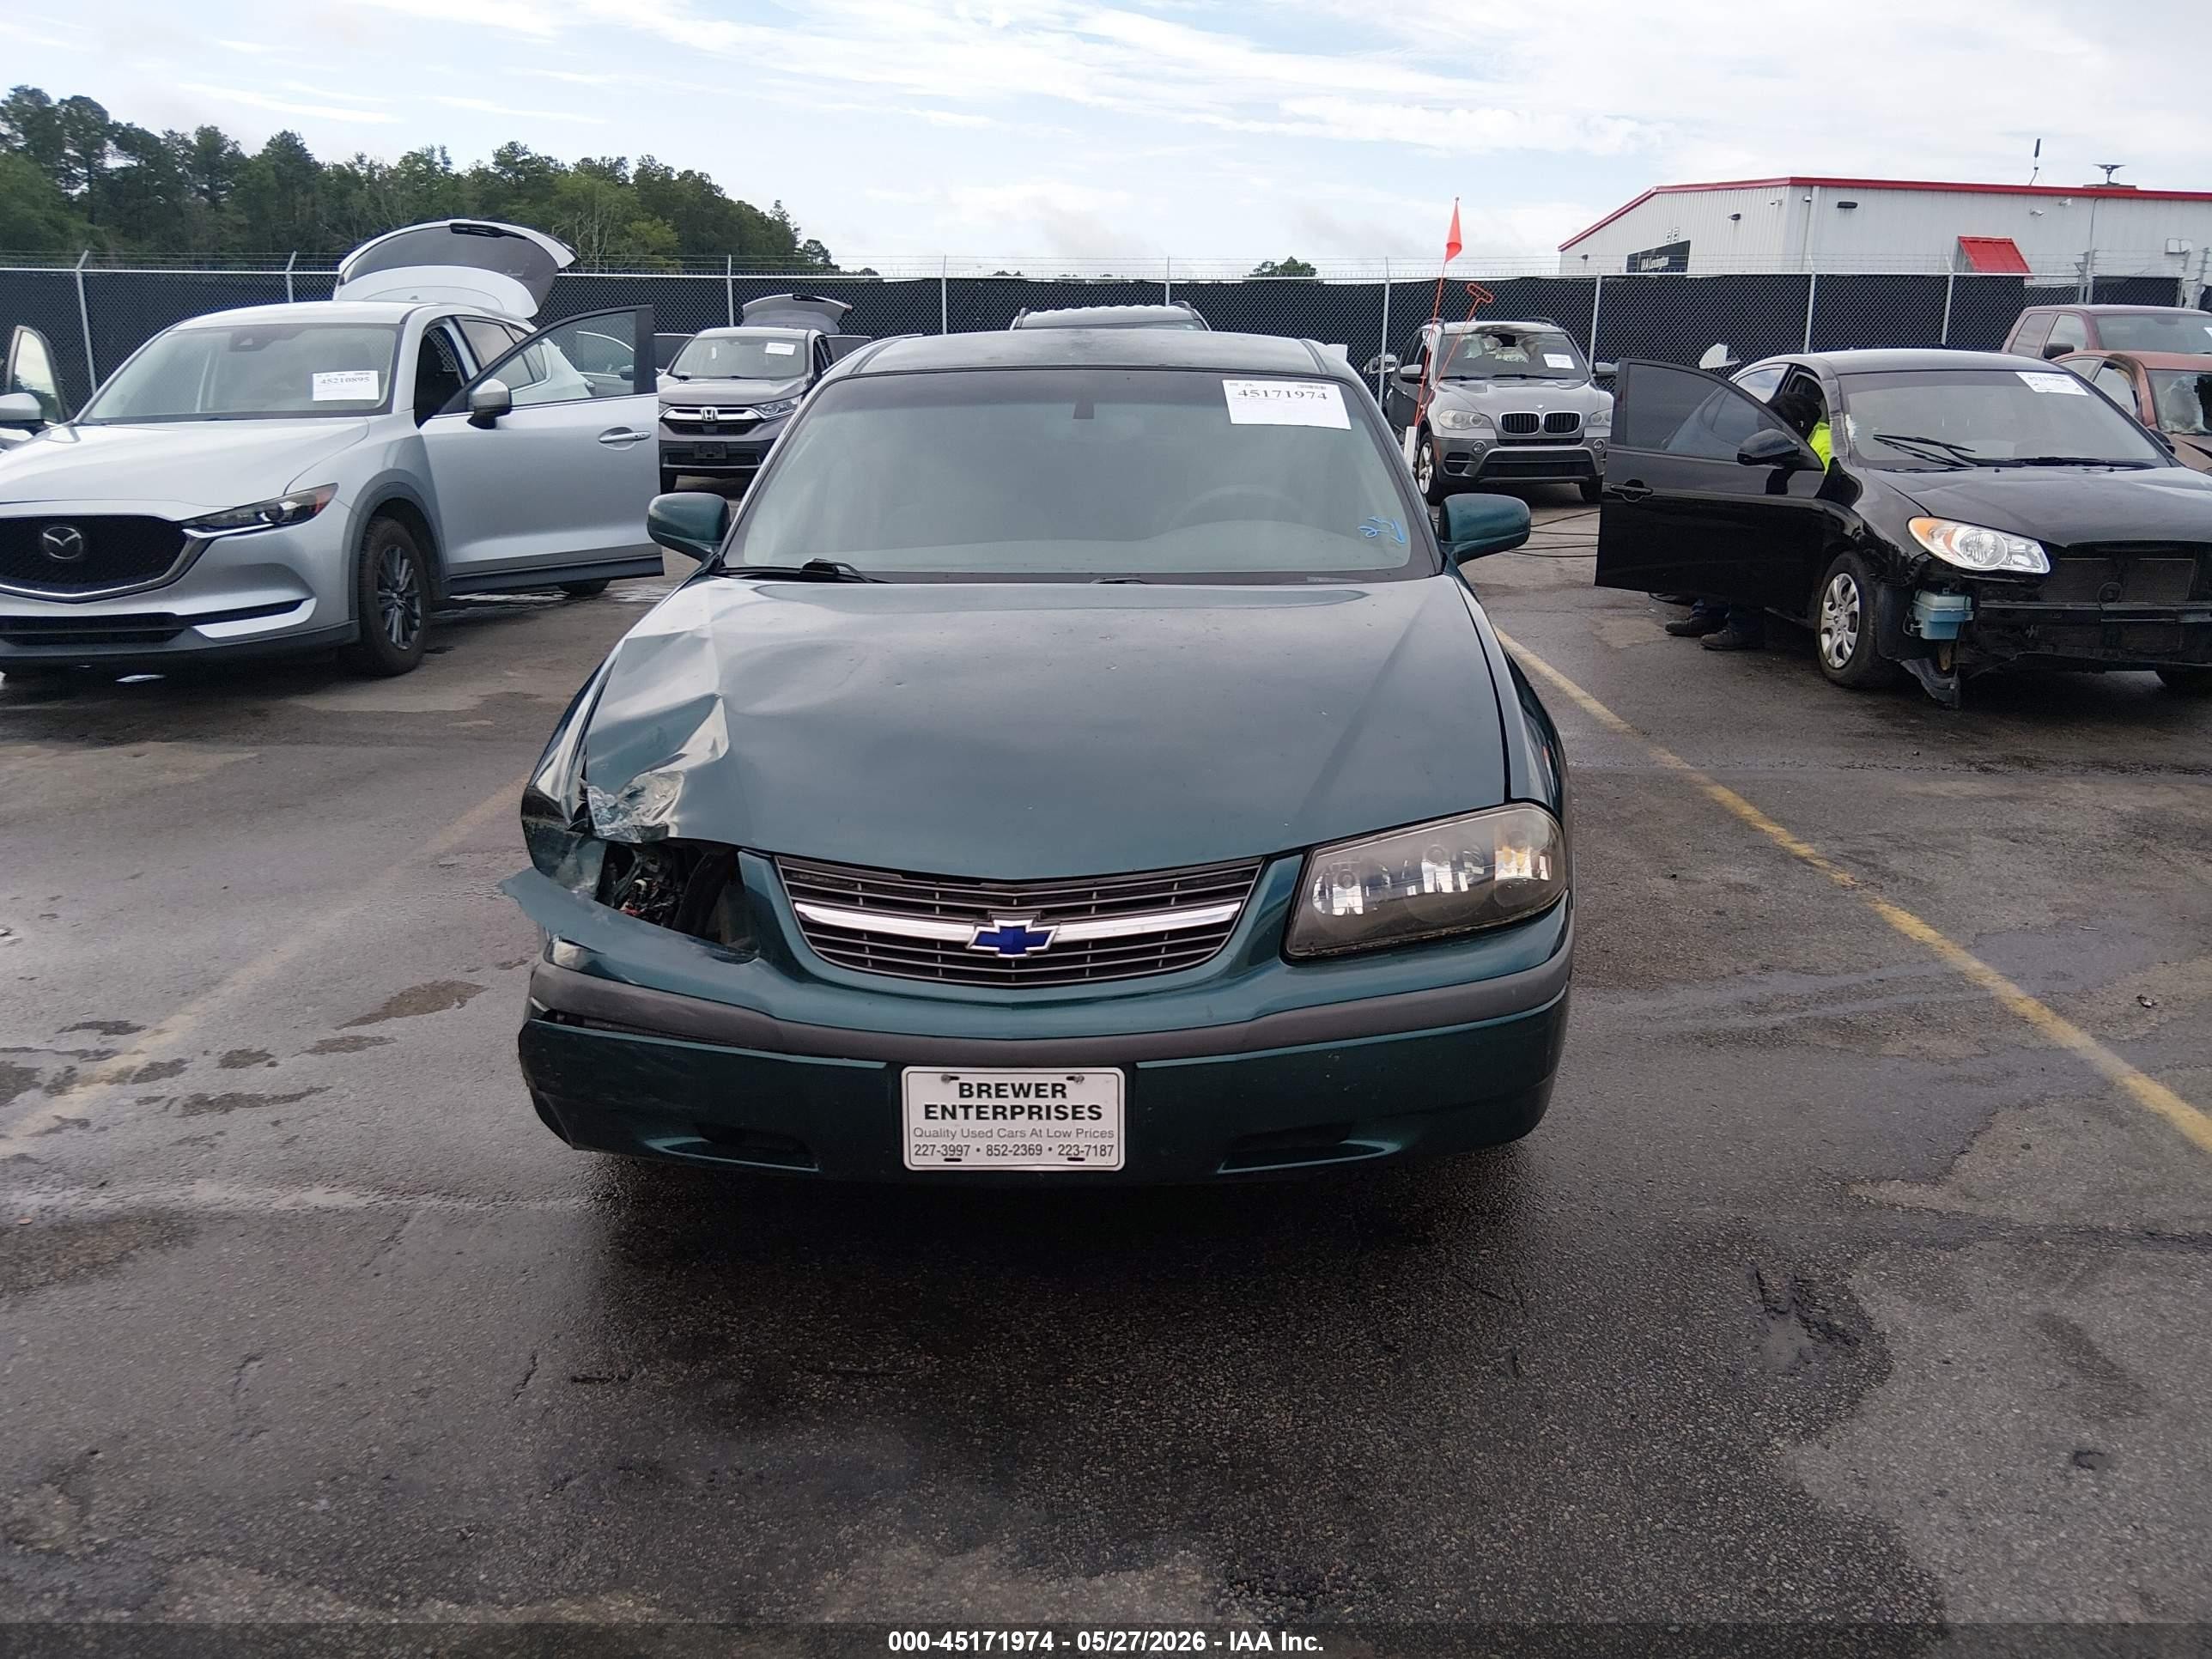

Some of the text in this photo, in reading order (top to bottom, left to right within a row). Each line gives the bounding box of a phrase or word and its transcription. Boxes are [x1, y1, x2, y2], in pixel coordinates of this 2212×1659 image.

[1237, 389, 1328, 400] 45171974
[958, 1082, 1067, 1099] BREWER
[924, 1103, 1103, 1121] ENTERPRISES
[913, 1127, 1115, 1140] Quality Used Cars At Low Prices
[914, 1143, 1115, 1157] 227-3997 852-2369 223-7187
